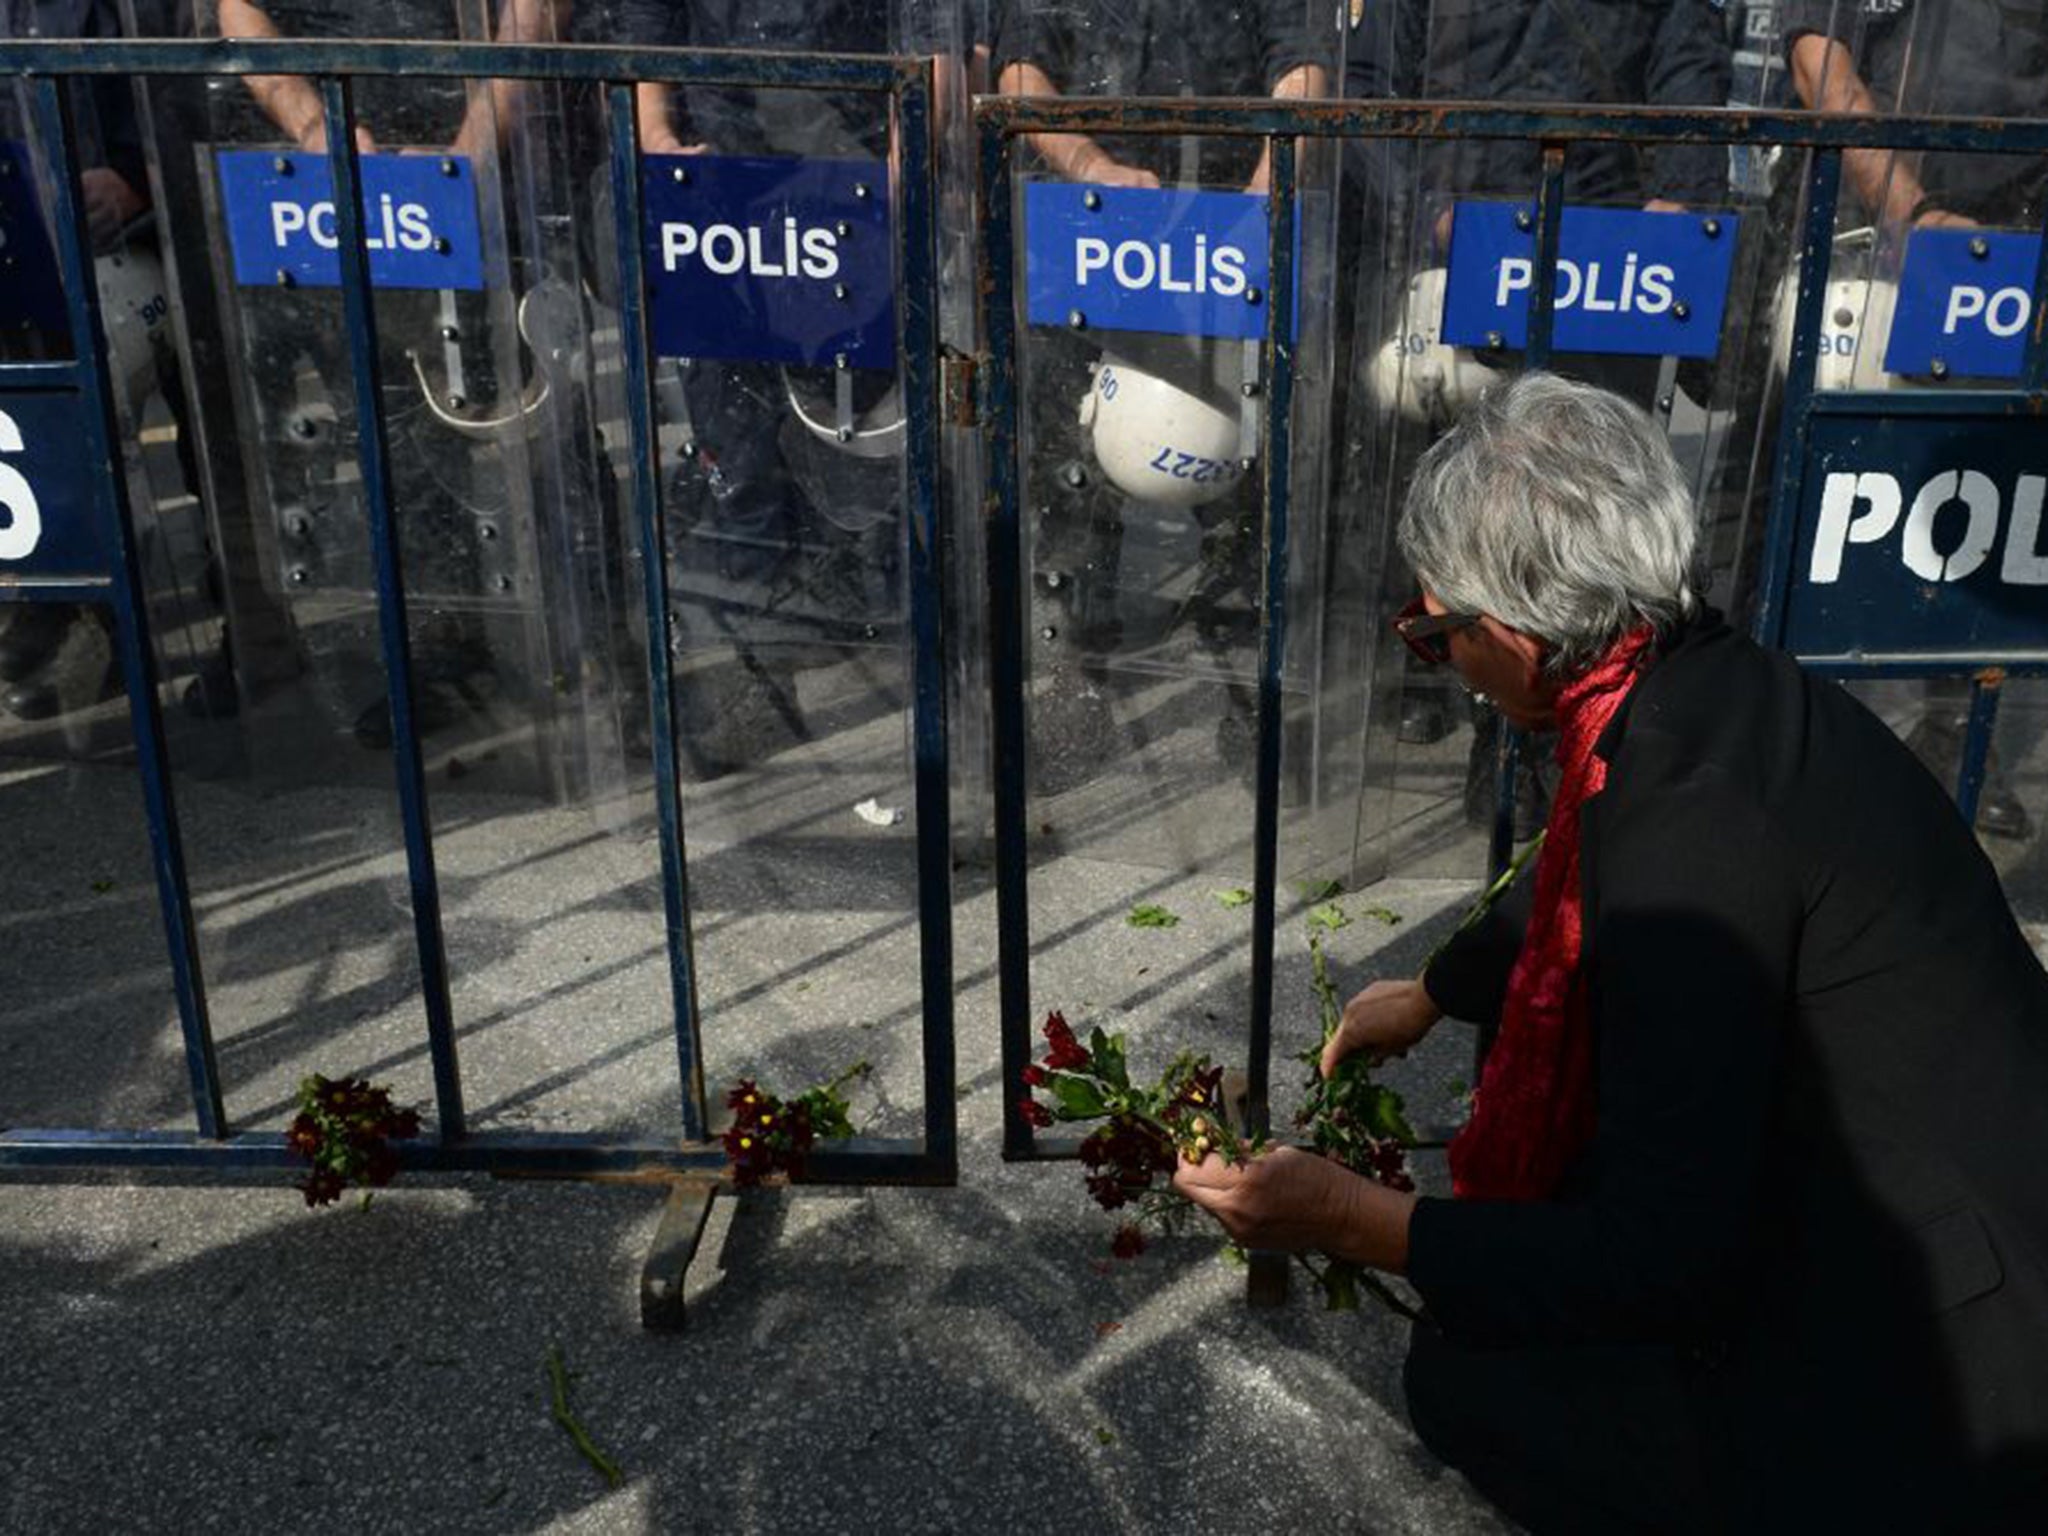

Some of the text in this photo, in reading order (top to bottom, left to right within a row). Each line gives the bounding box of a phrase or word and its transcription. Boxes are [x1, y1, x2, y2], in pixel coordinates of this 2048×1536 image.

[271, 193, 433, 250] POİS
[661, 217, 839, 279] POLİS
[1076, 233, 1247, 296] POLİS
[1496, 253, 1675, 314] POLİS
